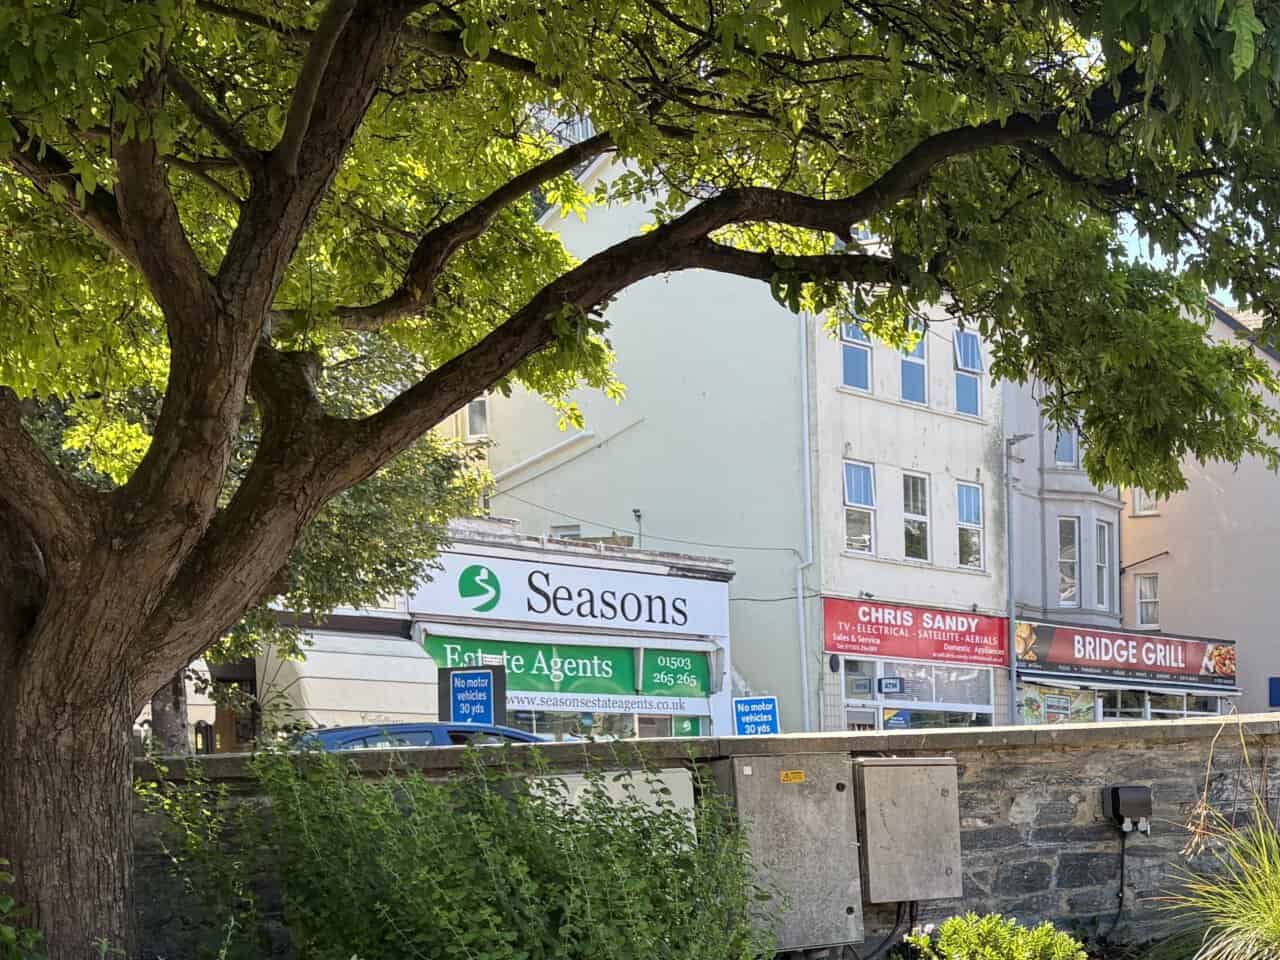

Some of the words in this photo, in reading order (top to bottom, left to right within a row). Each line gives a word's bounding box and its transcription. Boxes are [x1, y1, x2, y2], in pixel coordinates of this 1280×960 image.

[527, 570, 689, 626] Seasons
[858, 606, 913, 626] CHRIS
[922, 613, 979, 633] SANDY
[838, 621, 850, 631] TV
[857, 623, 909, 637] ELECTRICAL
[918, 629, 960, 642] SATELLITE
[965, 634, 999, 646] AERIALS
[1074, 635, 1137, 663] BRIDGE
[1142, 642, 1185, 668] GRILL
[443, 644, 524, 674] Estte
[531, 649, 613, 682] Agents
[657, 655, 692, 670] 01503
[454, 676, 466, 688] No
[467, 676, 489, 688] motor
[653, 672, 674, 686] 265
[676, 673, 697, 687] 265
[457, 689, 487, 701] vehicles
[460, 703, 470, 714] 30
[471, 702, 485, 716] yds
[737, 703, 750, 712] No
[750, 700, 773, 712] motor
[741, 711, 772, 723] vehicles
[744, 724, 756, 734] 30
[757, 723, 770, 735] yds
